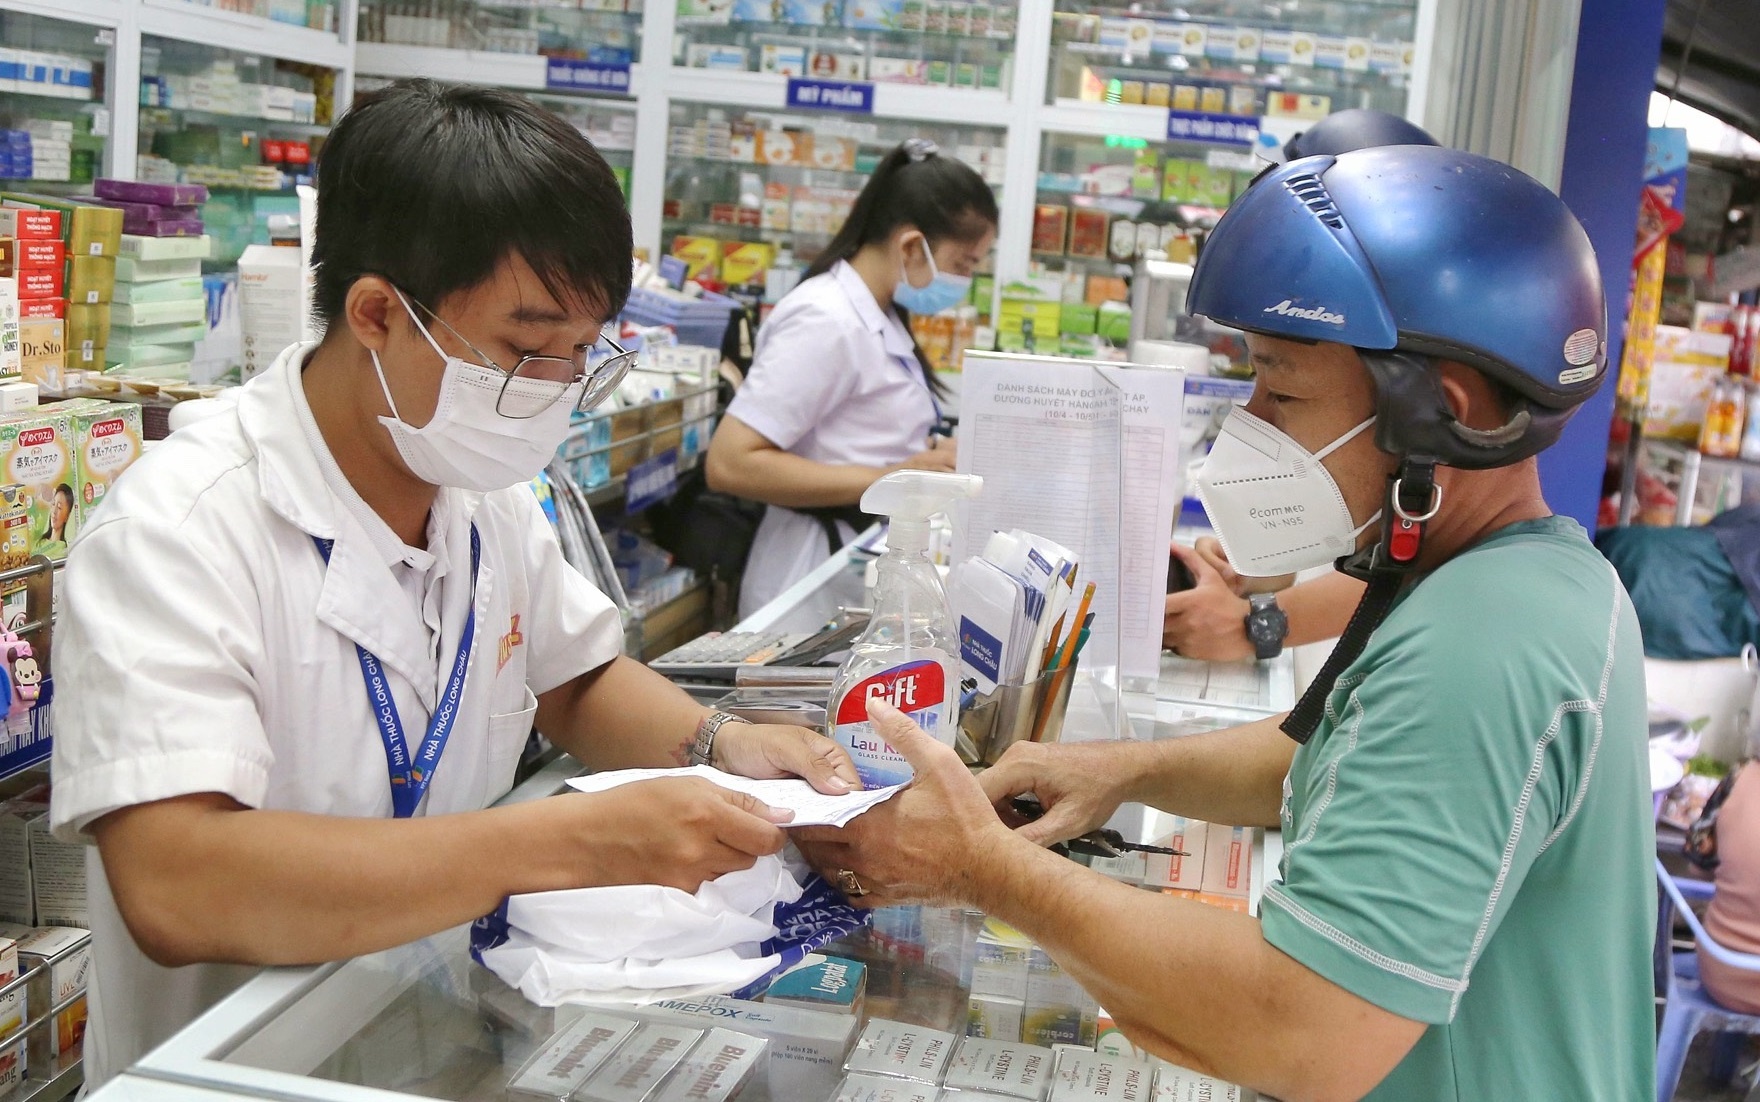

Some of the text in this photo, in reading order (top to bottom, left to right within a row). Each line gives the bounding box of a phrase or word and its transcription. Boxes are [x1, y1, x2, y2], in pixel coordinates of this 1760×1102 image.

[1264, 300, 1345, 325] Andos
[22, 341, 61, 357] Dr.Sto
[972, 646, 985, 661] LONG
[984, 656, 998, 671] CHÂU
[373, 677, 389, 706] LONG
[424, 650, 467, 761] NHÀ THUỐC LONG CHÂU
[866, 674, 917, 711] Gift
[381, 706, 399, 744] THUỐC
[391, 744, 404, 766] NHÀ
[852, 735, 878, 751] Lau
[896, 1033, 917, 1065] L-CYSTINE
[920, 1039, 943, 1070] PHILS-LIN
[992, 1050, 1015, 1081] L-CYSTINE
[1020, 1054, 1042, 1085] PHILS-LIN
[1094, 1063, 1113, 1096] L-CYSTINE
[1124, 1069, 1140, 1101] PHILS-LIN
